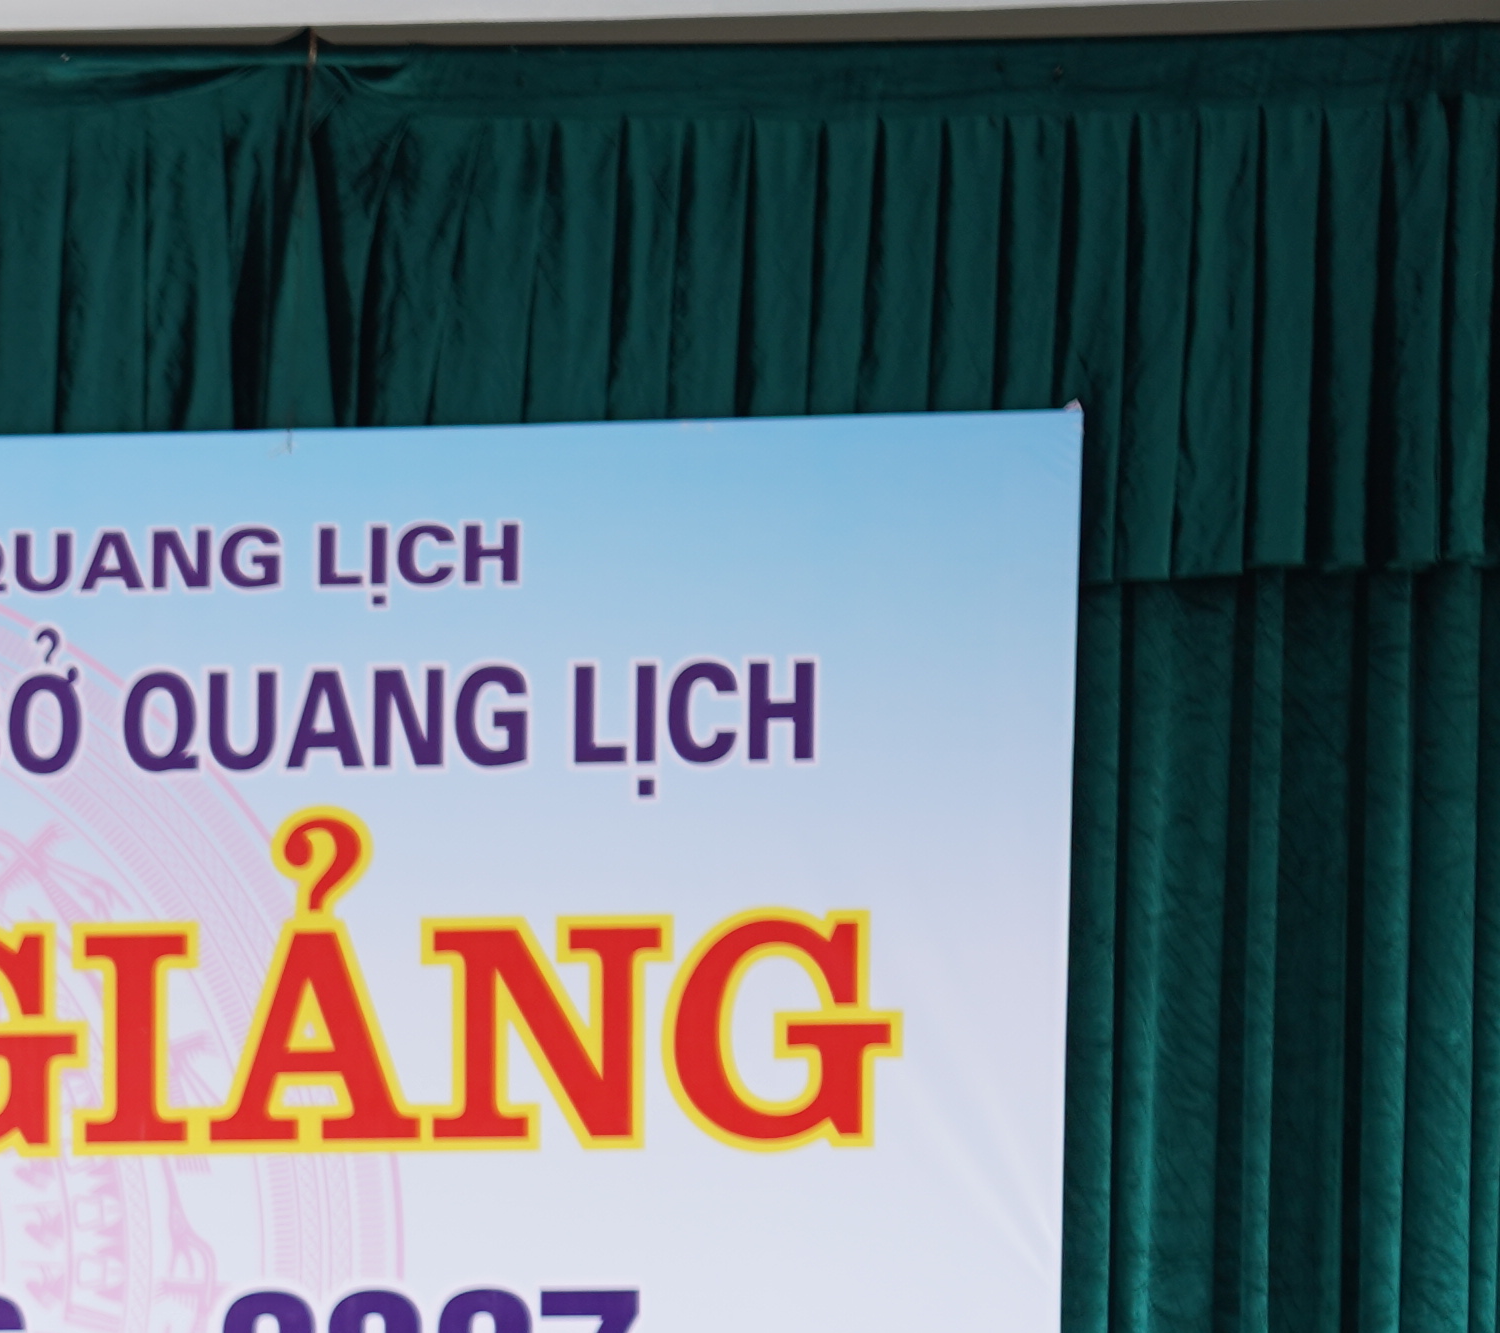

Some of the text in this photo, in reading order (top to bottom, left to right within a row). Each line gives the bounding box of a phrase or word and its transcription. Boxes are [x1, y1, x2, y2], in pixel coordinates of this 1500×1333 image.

[318, 523, 520, 605] LỊCH
[122, 666, 527, 773] QUANG
[573, 661, 815, 797] LỊCH
